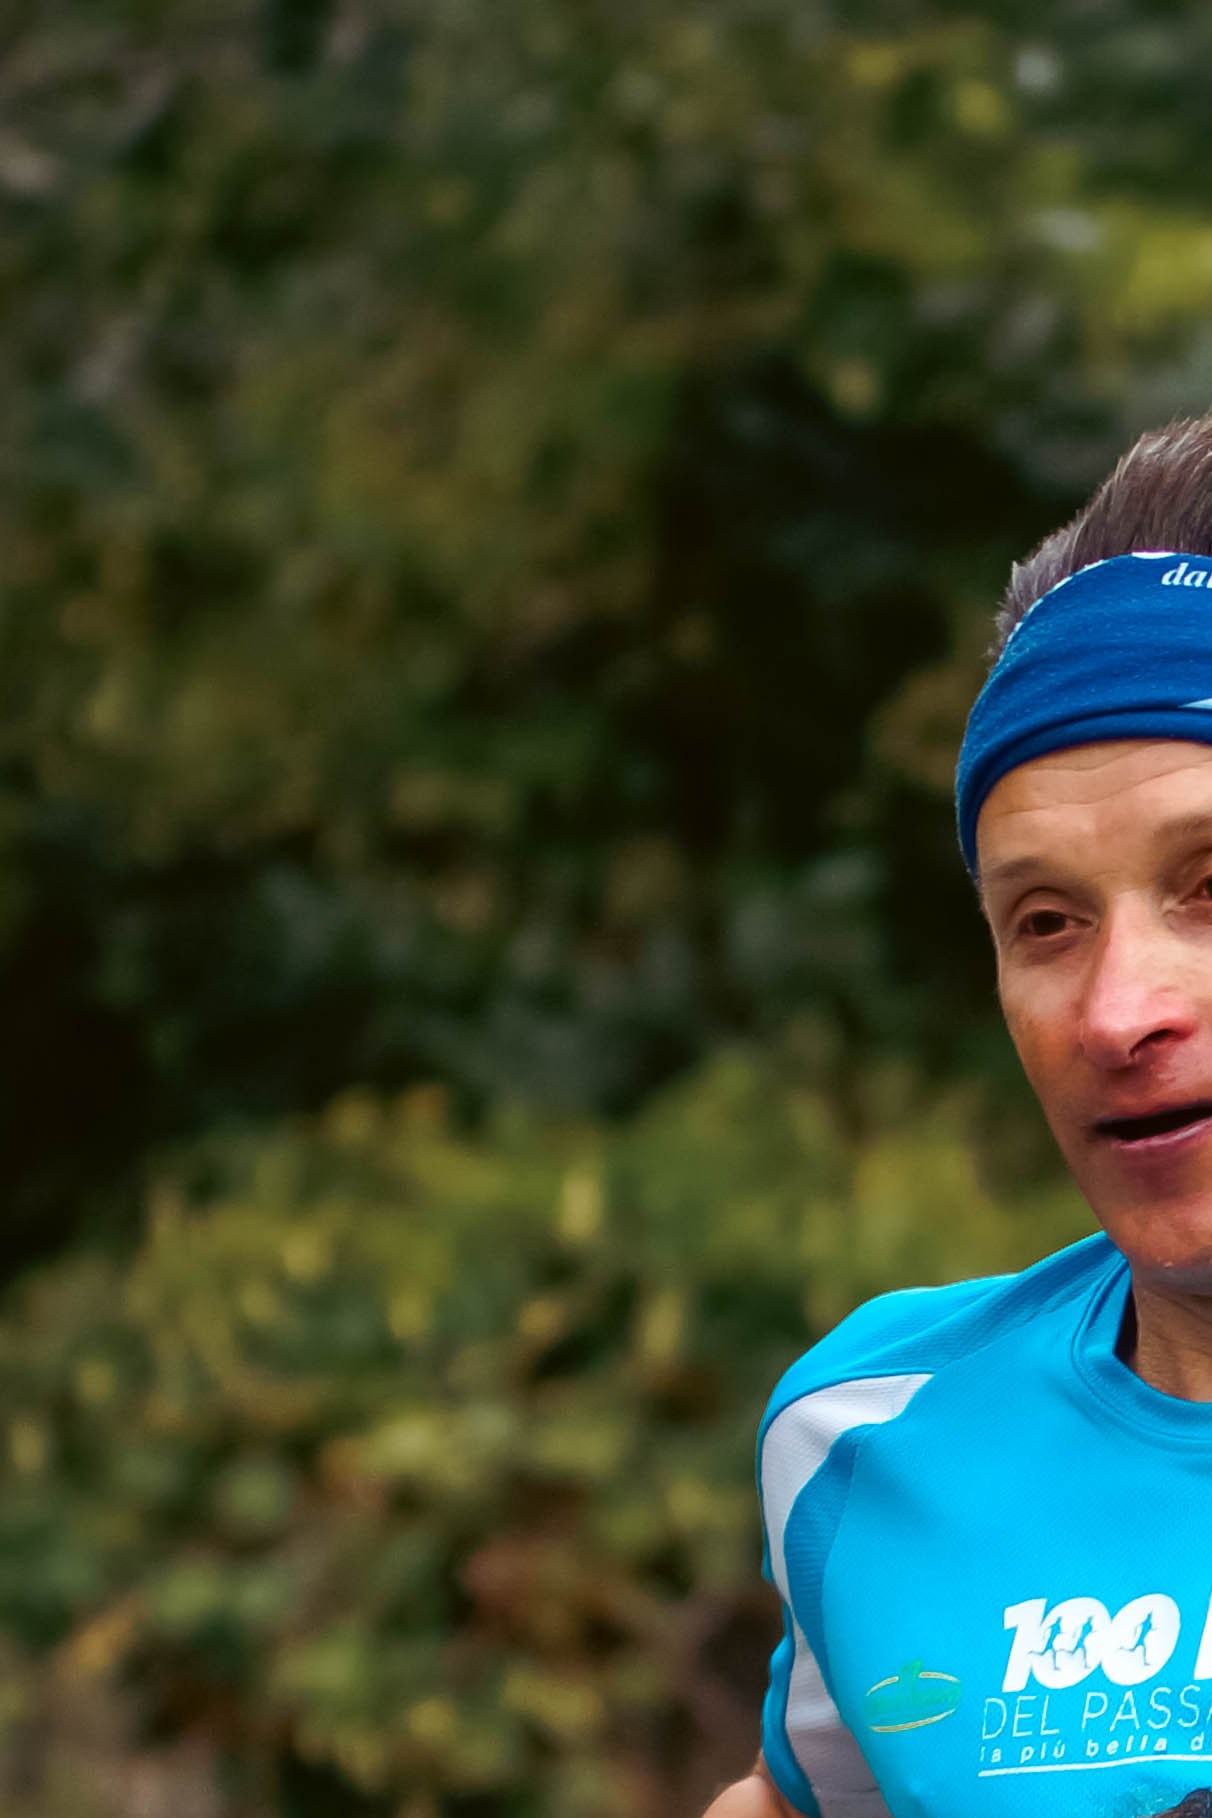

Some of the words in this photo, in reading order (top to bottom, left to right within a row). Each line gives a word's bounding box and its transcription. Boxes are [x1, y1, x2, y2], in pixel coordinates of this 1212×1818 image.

[1002, 1593, 1181, 1692] 100
[981, 1694, 1061, 1740] DEL
[1086, 1731, 1167, 1756] bella
